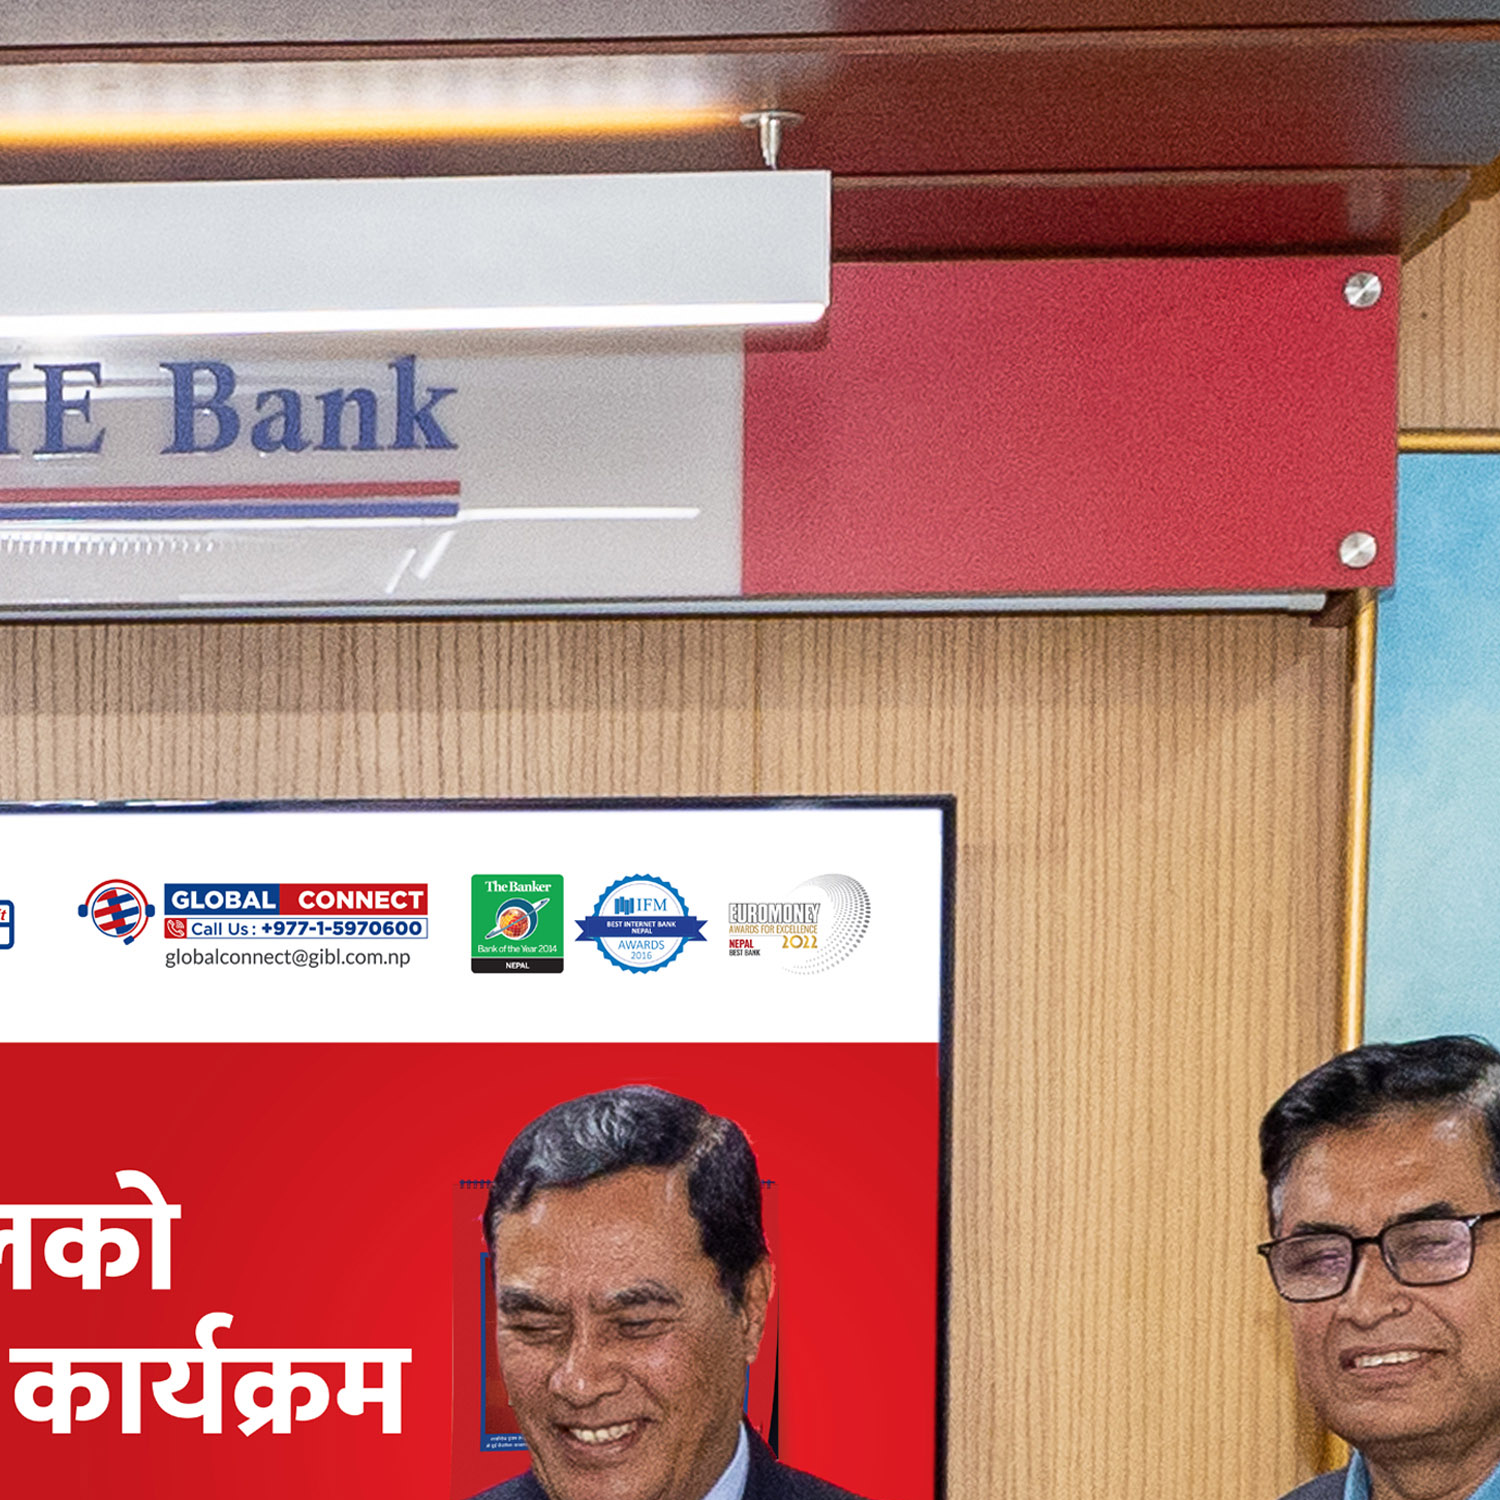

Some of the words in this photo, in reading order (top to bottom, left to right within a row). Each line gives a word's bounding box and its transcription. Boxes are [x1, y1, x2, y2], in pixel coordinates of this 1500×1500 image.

[160, 354, 461, 456] Bank
[485, 880, 509, 892] The
[509, 880, 551, 892] Banker
[171, 890, 276, 910] GLOBAL
[298, 890, 424, 910] CONNECT
[637, 898, 667, 911] IFM
[728, 902, 821, 924] EUROMONEY
[190, 921, 224, 937] Call
[261, 921, 422, 937] +977-1-5970600
[728, 925, 759, 934] AWARDS
[760, 925, 774, 934] FOR
[776, 925, 818, 934] EXCELLENCE
[478, 944, 498, 953] Bank
[498, 944, 506, 953] of
[507, 944, 519, 953] the
[521, 944, 537, 953] Year
[538, 944, 557, 953] 2014
[618, 940, 664, 950] AWARDS
[728, 939, 754, 948] NEPAL
[782, 935, 818, 949] 2022
[165, 948, 411, 967] globalconnect@gibl.com.np
[631, 951, 652, 960] 2016
[9, 1311, 412, 1437] कार्यक्रम
